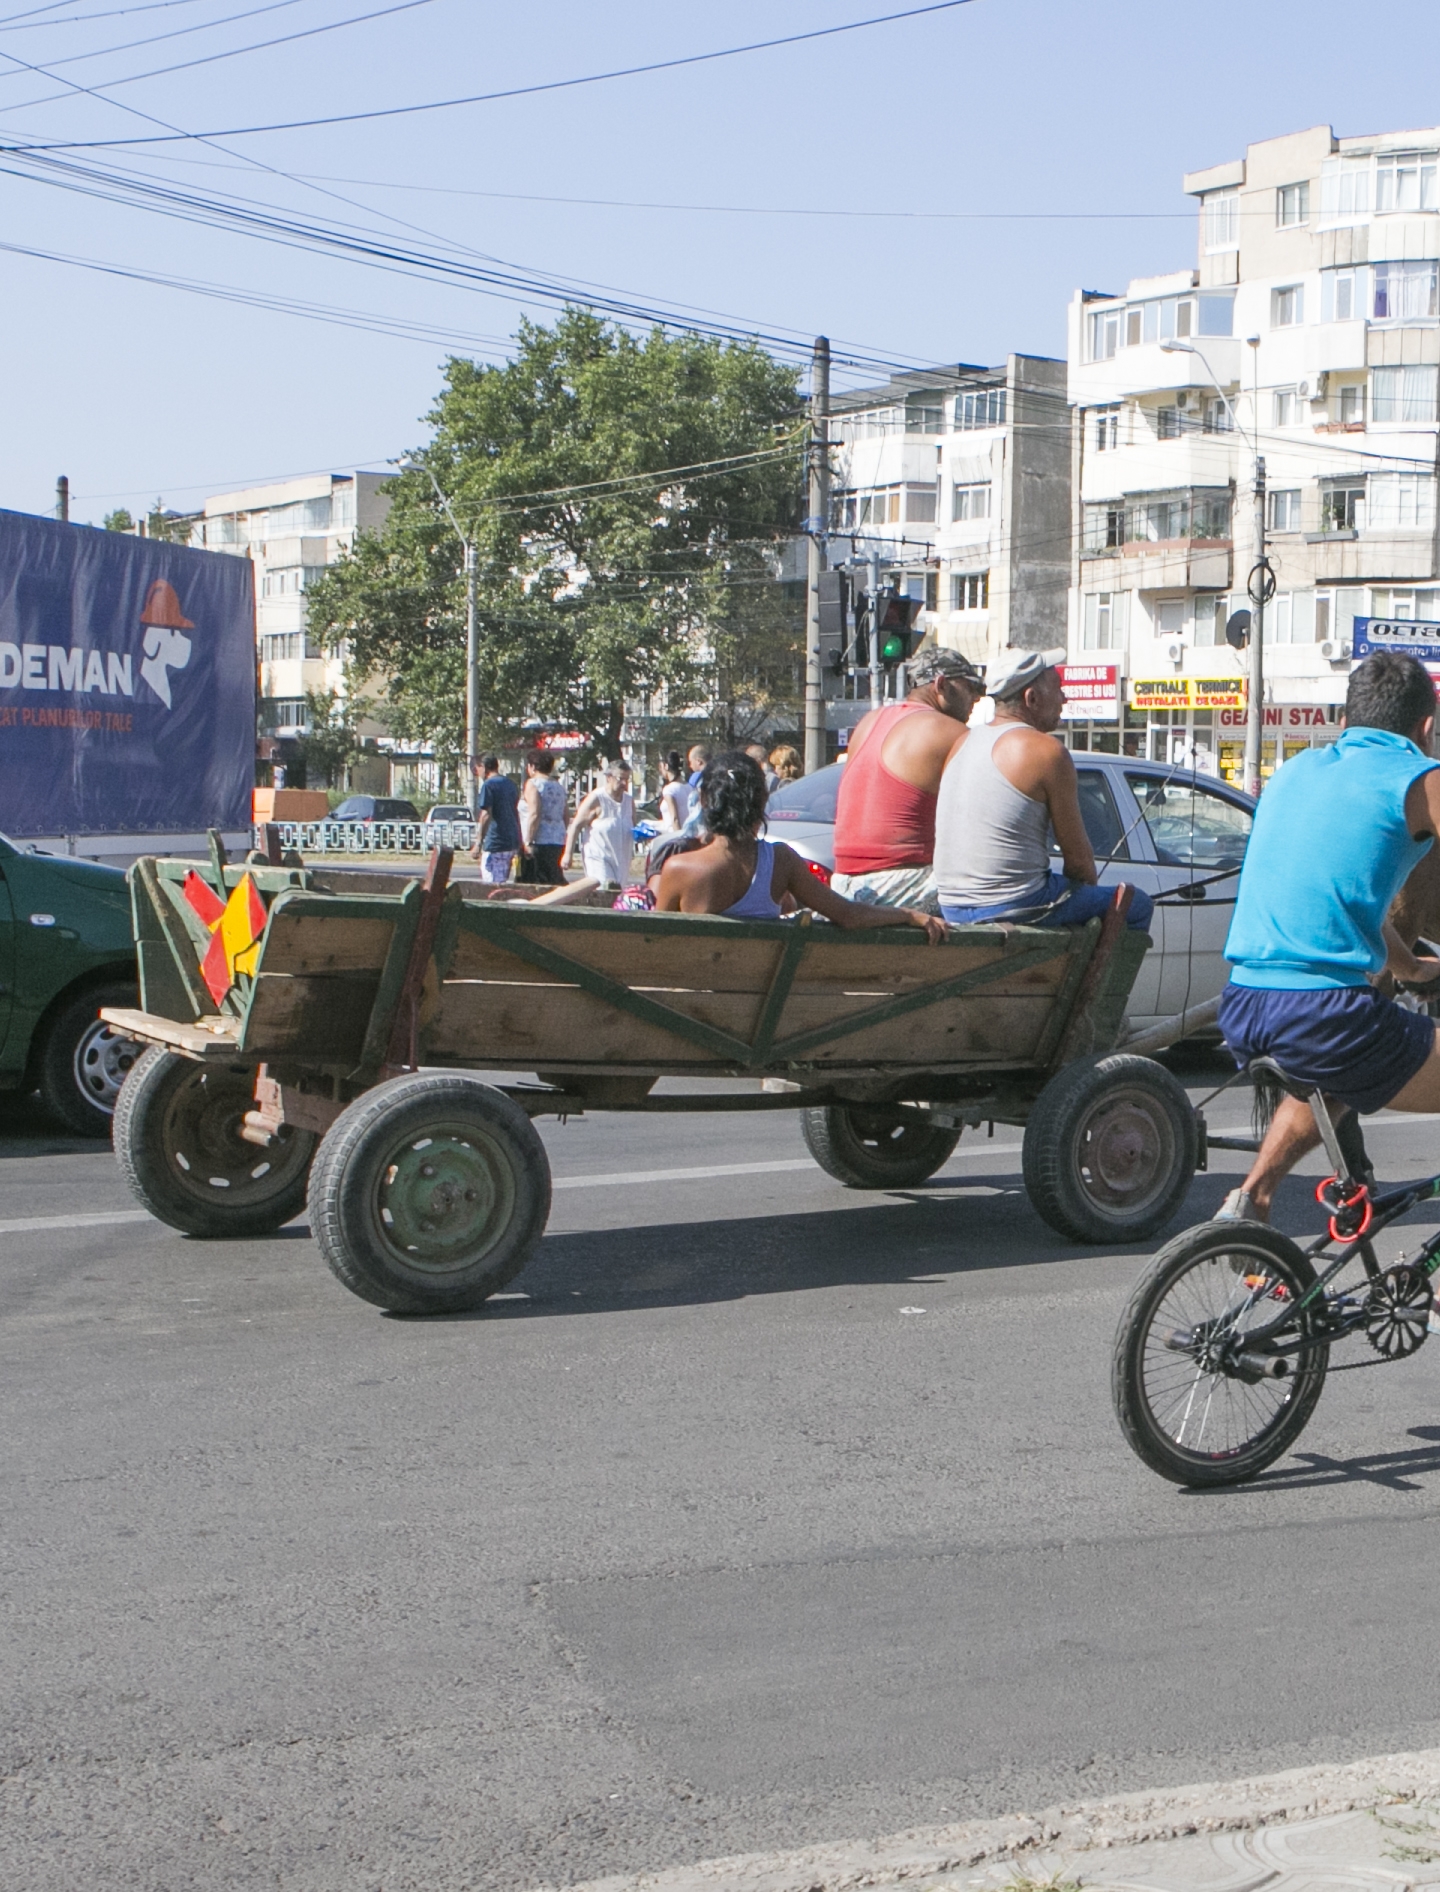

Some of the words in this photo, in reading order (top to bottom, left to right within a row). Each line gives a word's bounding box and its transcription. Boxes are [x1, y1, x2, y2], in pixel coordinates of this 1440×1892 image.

[1064, 667, 1096, 681] FABRIKA
[1096, 667, 1108, 681] DE
[1103, 683, 1116, 697] USI
[1134, 680, 1188, 695] CENTRALE
[1195, 679, 1242, 694] TERMICE
[1196, 696, 1209, 706] DE
[1211, 696, 1240, 706] GAZE
[22, 707, 102, 729] PLANURILOR
[105, 712, 133, 732] TALE
